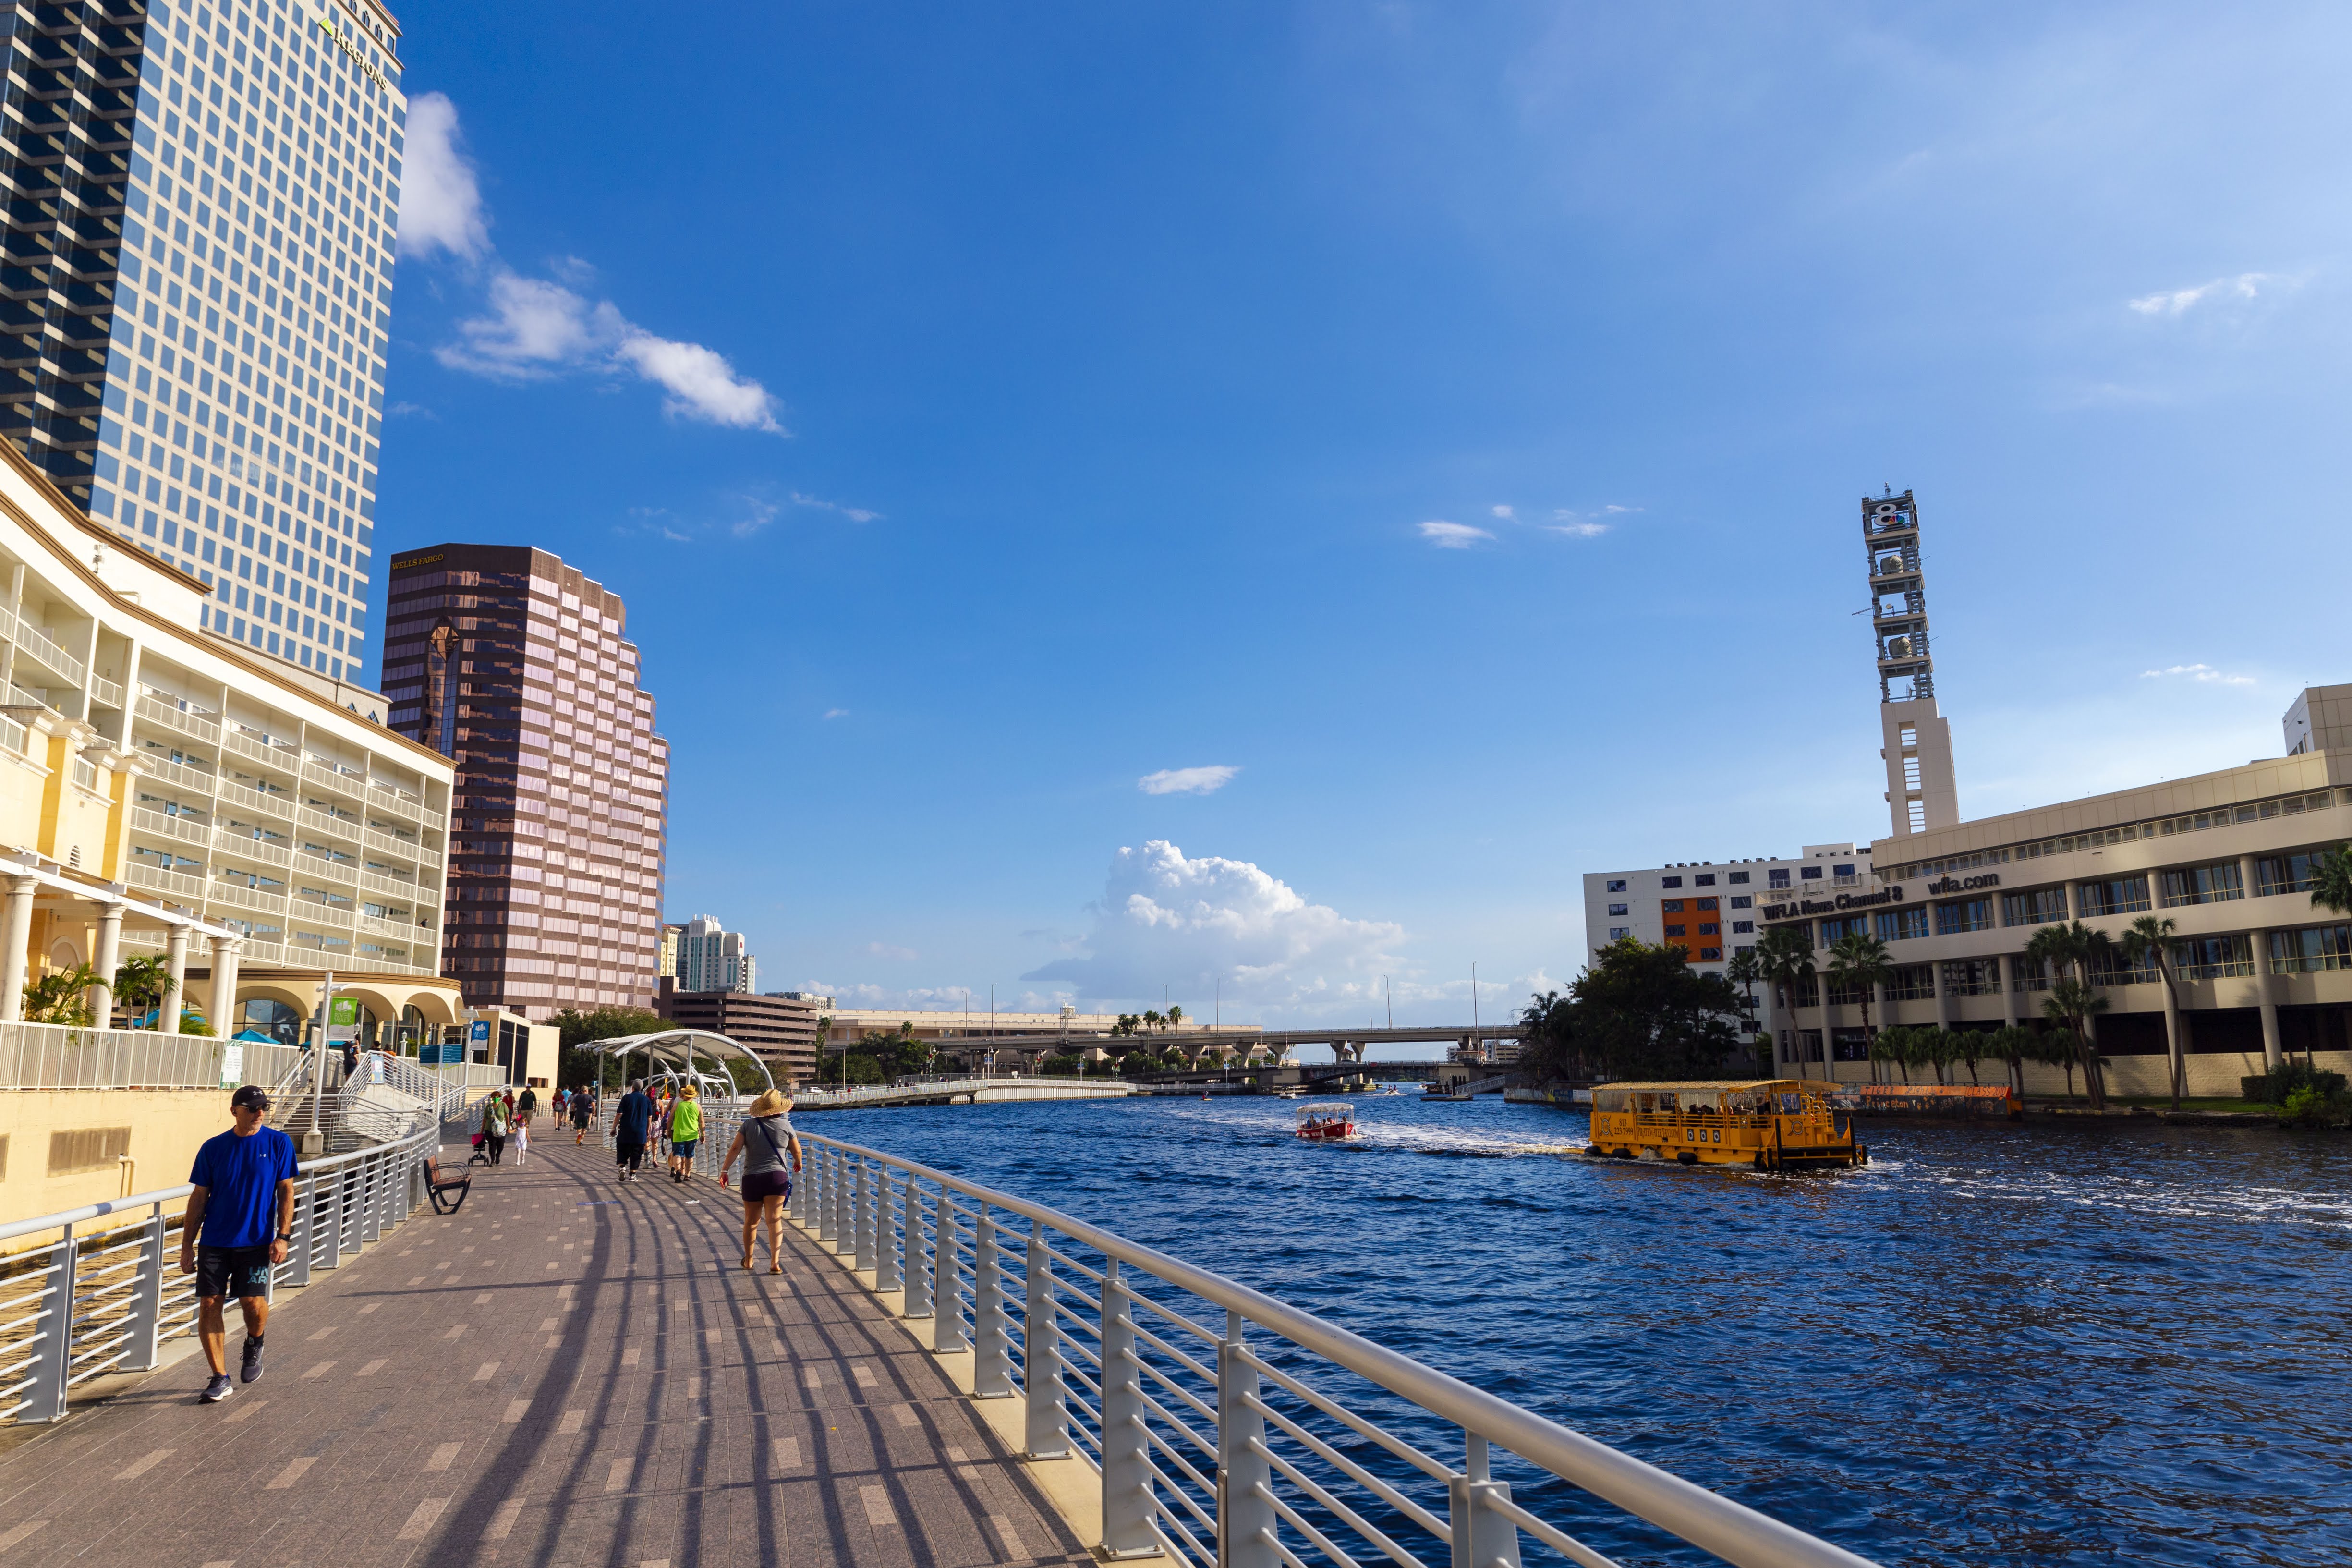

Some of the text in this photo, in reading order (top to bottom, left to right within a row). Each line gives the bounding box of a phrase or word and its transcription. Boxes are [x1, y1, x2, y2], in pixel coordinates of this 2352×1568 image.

[334, 27, 387, 90] REGIONS
[1875, 503, 1898, 526] 8
[392, 554, 444, 570] WELLS FARGO
[1928, 873, 1999, 895] wfla.com
[1763, 886, 1903, 920] WFLA News Channel 8
[1865, 1086, 1894, 1094] TIGER
[1967, 1087, 1990, 1097] CLASS
[1619, 1118, 1627, 1127] 813
[1614, 1127, 1634, 1135] 223-7999
